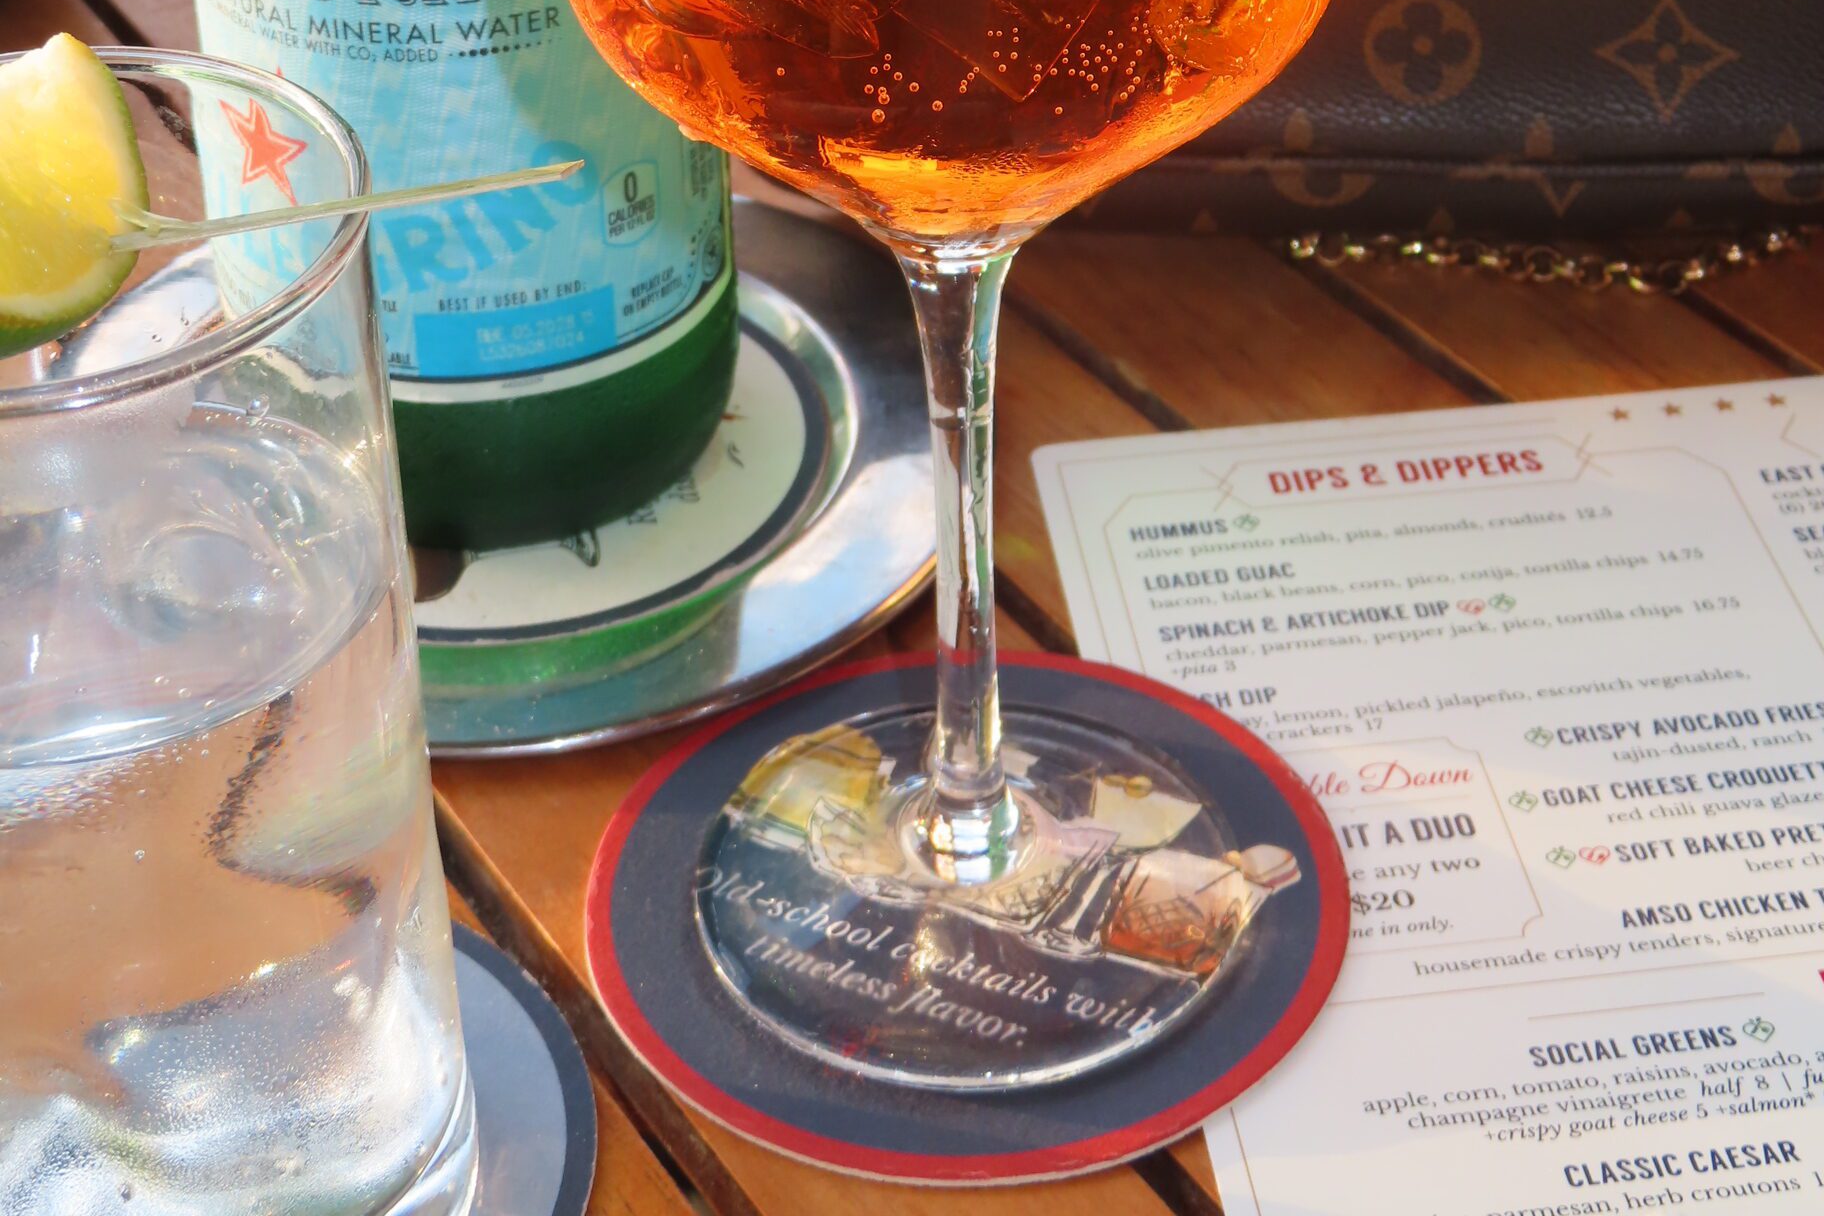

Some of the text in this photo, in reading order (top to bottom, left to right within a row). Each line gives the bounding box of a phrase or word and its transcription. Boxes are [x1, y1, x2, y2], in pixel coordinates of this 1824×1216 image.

[307, 13, 443, 45] MINERAL
[456, 6, 561, 41] WATER
[305, 34, 341, 58] WITH
[383, 47, 438, 63] ADDED
[623, 171, 638, 204] 0
[608, 194, 655, 226] CALORIES
[438, 280, 587, 313] BEST IF USED BY END:
[1268, 449, 1545, 495] DIPS & DIPPERS
[1759, 464, 1814, 484] EAST
[1130, 519, 1229, 542] HUMMUS
[1136, 546, 1184, 561] olive
[1190, 537, 1275, 558] pimento
[1279, 531, 1340, 548] relish,
[1344, 527, 1388, 544] pita,
[1393, 518, 1484, 537] almonds,
[1144, 562, 1296, 592] LOADED GUAC
[1148, 594, 1215, 611] bacon,
[1221, 588, 1276, 603] black
[1280, 581, 1343, 598] beans,
[1349, 578, 1400, 593] corn,
[1405, 572, 1455, 589] pico,
[1524, 558, 1591, 577] tortilla
[1595, 554, 1649, 571] chips
[1158, 600, 1451, 642] SPINACH & ARTICHOKE DIP
[1165, 644, 1255, 663] cheddar,
[1260, 634, 1368, 656] parmesan,
[1372, 626, 1444, 646] pepper
[1448, 620, 1497, 639] jack,
[1501, 615, 1552, 634] pico,
[1555, 608, 1625, 626] tortilla
[1629, 601, 1684, 620] chips
[1239, 686, 1278, 707] DIP
[1273, 704, 1350, 724] lemon,
[1354, 695, 1431, 717] pickled
[1536, 677, 1634, 701] escovitch
[1638, 666, 1751, 690] vegetables,
[1266, 717, 1384, 741] crackers 17
[1556, 701, 1824, 746] CRISPY AVOCADO FRIES
[1752, 729, 1814, 749] ranch
[1359, 760, 1473, 794] Down
[1542, 784, 1603, 808] GOAT
[1610, 772, 1703, 800] CHEESE
[1607, 806, 1643, 824] red
[1648, 801, 1697, 819] chili
[1703, 795, 1766, 817] guava
[1340, 812, 1477, 850] IT A DUO
[1614, 838, 1676, 863] SOFT
[1683, 830, 1767, 856] BAKED
[1374, 861, 1421, 880] any
[1430, 855, 1482, 874] two
[1744, 857, 1796, 874] beer
[1350, 889, 1416, 916] $20
[1621, 902, 1693, 929] AMSO
[1698, 888, 1811, 921] CHICKEN
[1380, 920, 1401, 934] in
[1407, 914, 1455, 934] only.
[1413, 947, 1548, 976] housemade
[1553, 939, 1623, 961] crispy
[1628, 932, 1721, 953] tenders,
[745, 933, 1029, 1047] timeless flavor.
[1528, 1024, 1738, 1068] SOCIAL GREENS
[1363, 1090, 1438, 1116] apple,
[1442, 1085, 1507, 1104] corn,
[1512, 1075, 1608, 1096] tomato,
[1612, 1064, 1698, 1086] raisins,
[1704, 1049, 1810, 1076] avocado,
[1407, 1100, 1550, 1130] champagne
[1557, 1086, 1688, 1112] vinaigrette
[1699, 1074, 1744, 1099] half
[1754, 1074, 1770, 1091] 8
[1484, 1119, 1562, 1142] +crispy
[1568, 1115, 1616, 1137] goat
[1623, 1106, 1689, 1128] cheese
[1696, 1102, 1709, 1120] 5
[1562, 1139, 1802, 1188] CLASSIC CAESAR
[1622, 1186, 1684, 1211] herb
[1691, 1175, 1802, 1201] croutons
